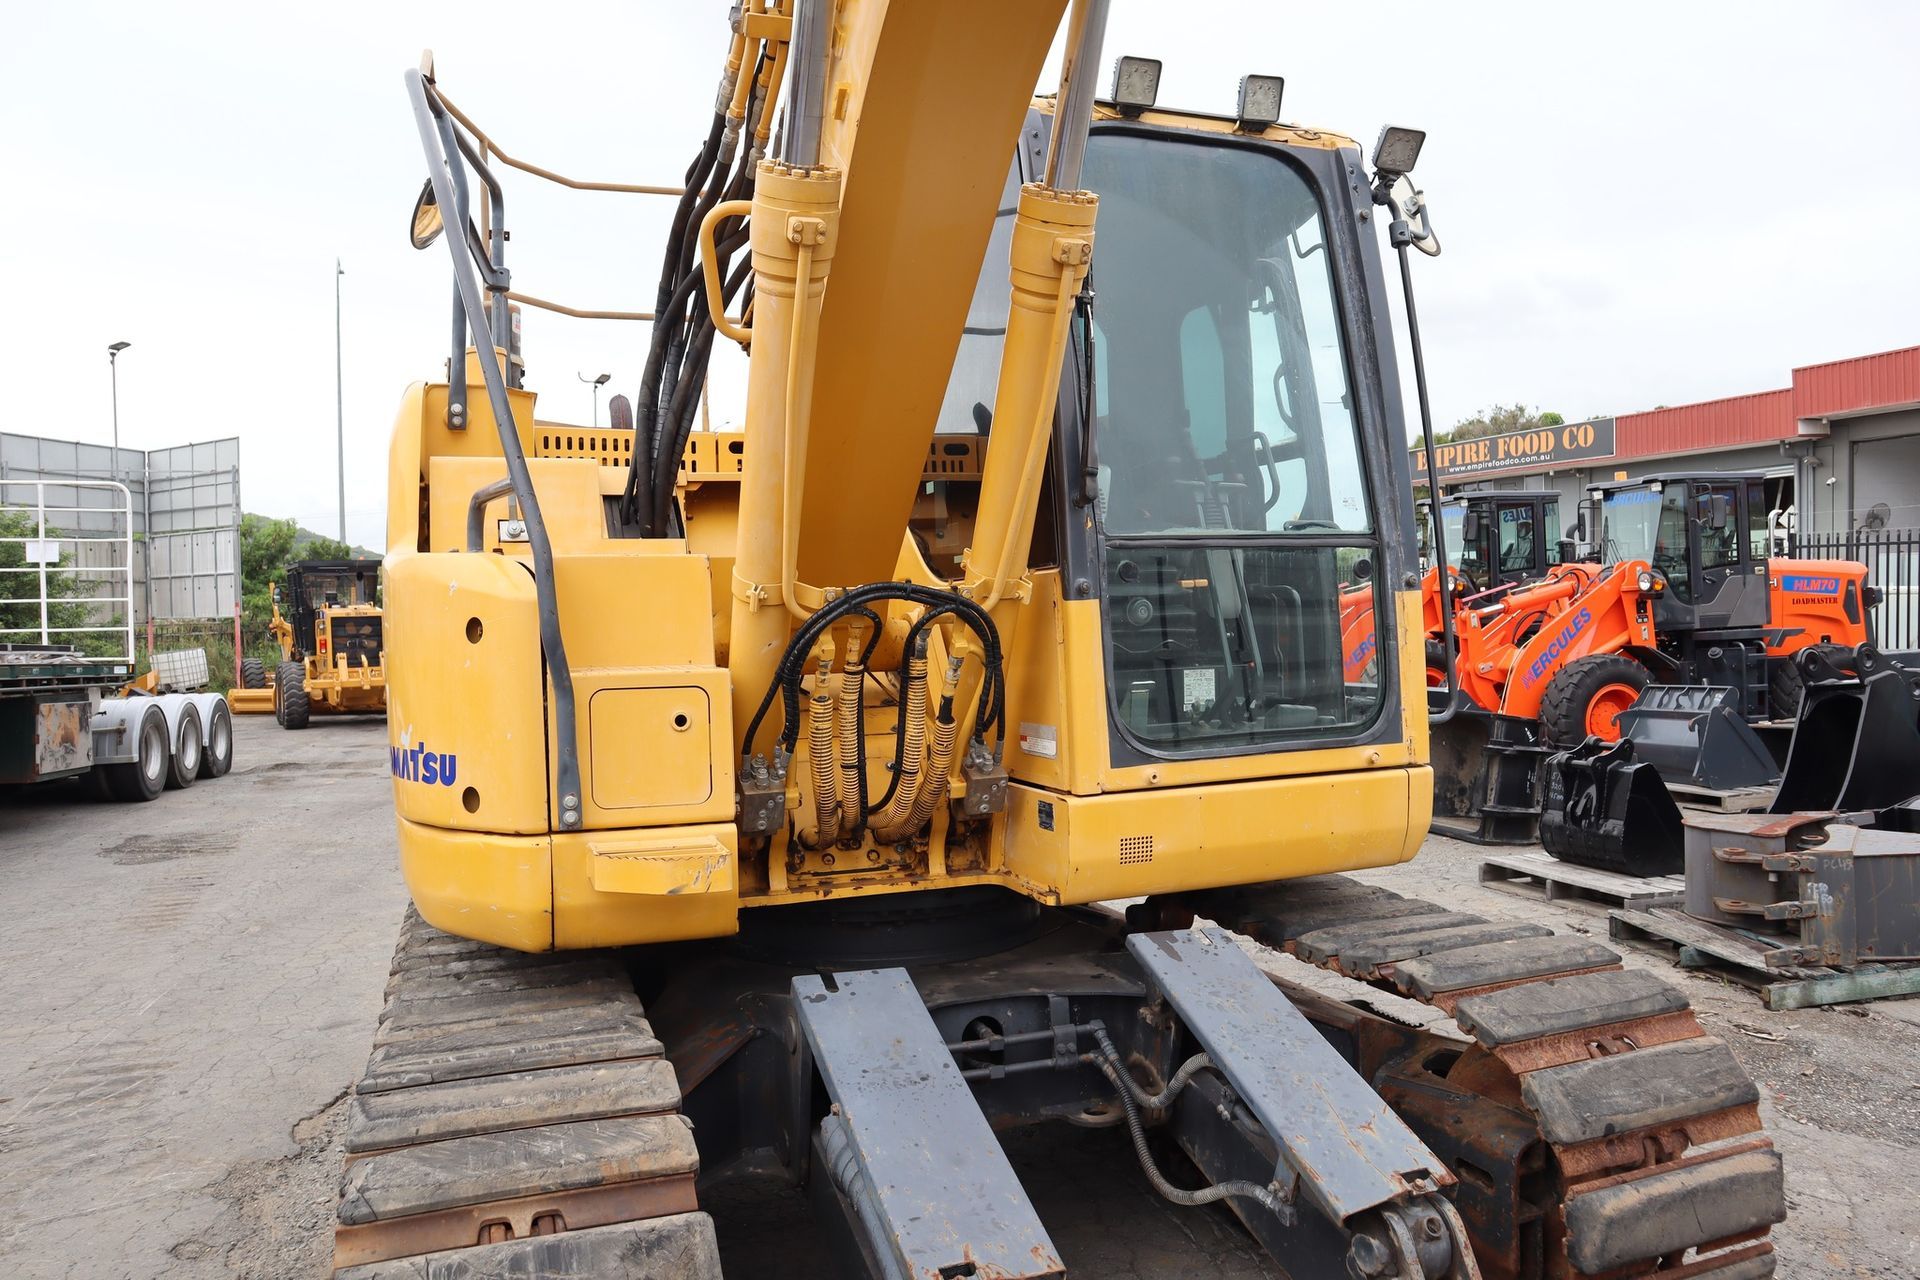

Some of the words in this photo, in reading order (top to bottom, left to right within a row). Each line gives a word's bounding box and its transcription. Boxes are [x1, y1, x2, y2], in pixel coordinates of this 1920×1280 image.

[1497, 430, 1556, 459] FOOD
[1562, 424, 1596, 450] CO
[1449, 453, 1551, 473] www.empirefoodco.com.au
[1793, 578, 1836, 592] HLM70
[1792, 596, 1838, 606] LOADMASTER
[1521, 607, 1592, 689] HERCULES
[389, 741, 457, 787] MATSU
